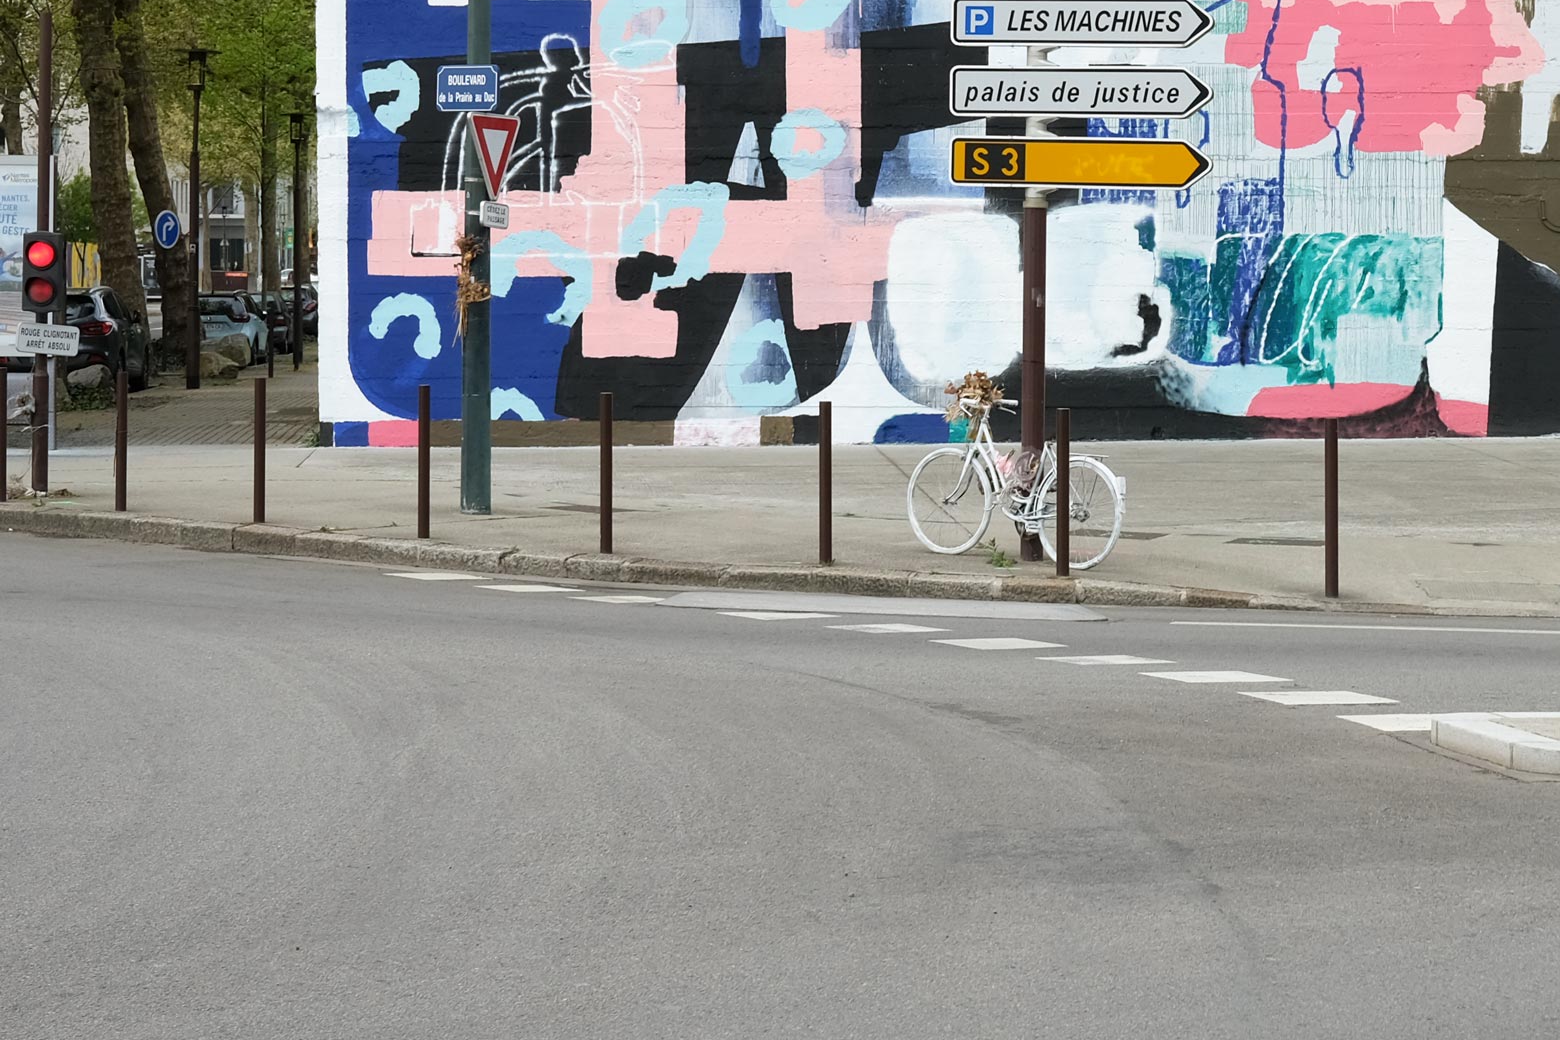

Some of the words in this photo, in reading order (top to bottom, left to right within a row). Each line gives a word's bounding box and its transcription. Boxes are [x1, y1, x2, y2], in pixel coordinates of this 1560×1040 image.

[970, 8, 989, 33] P
[1007, 10, 1049, 32] LES
[1054, 10, 1182, 33] MACHINES
[447, 74, 487, 86] BOULEVARD
[438, 91, 446, 103] de
[447, 91, 454, 103] la
[455, 91, 473, 103] Prairie
[474, 93, 482, 103] au
[483, 91, 495, 102] Duc
[964, 80, 1040, 107] palais
[1052, 80, 1080, 103] de
[1090, 81, 1180, 108] justice
[20, 327, 41, 337] ROUGE
[43, 329, 78, 341] CLIGNOTANT
[26, 339, 45, 349] ARRÊT
[47, 341, 71, 351] ABSOLU
